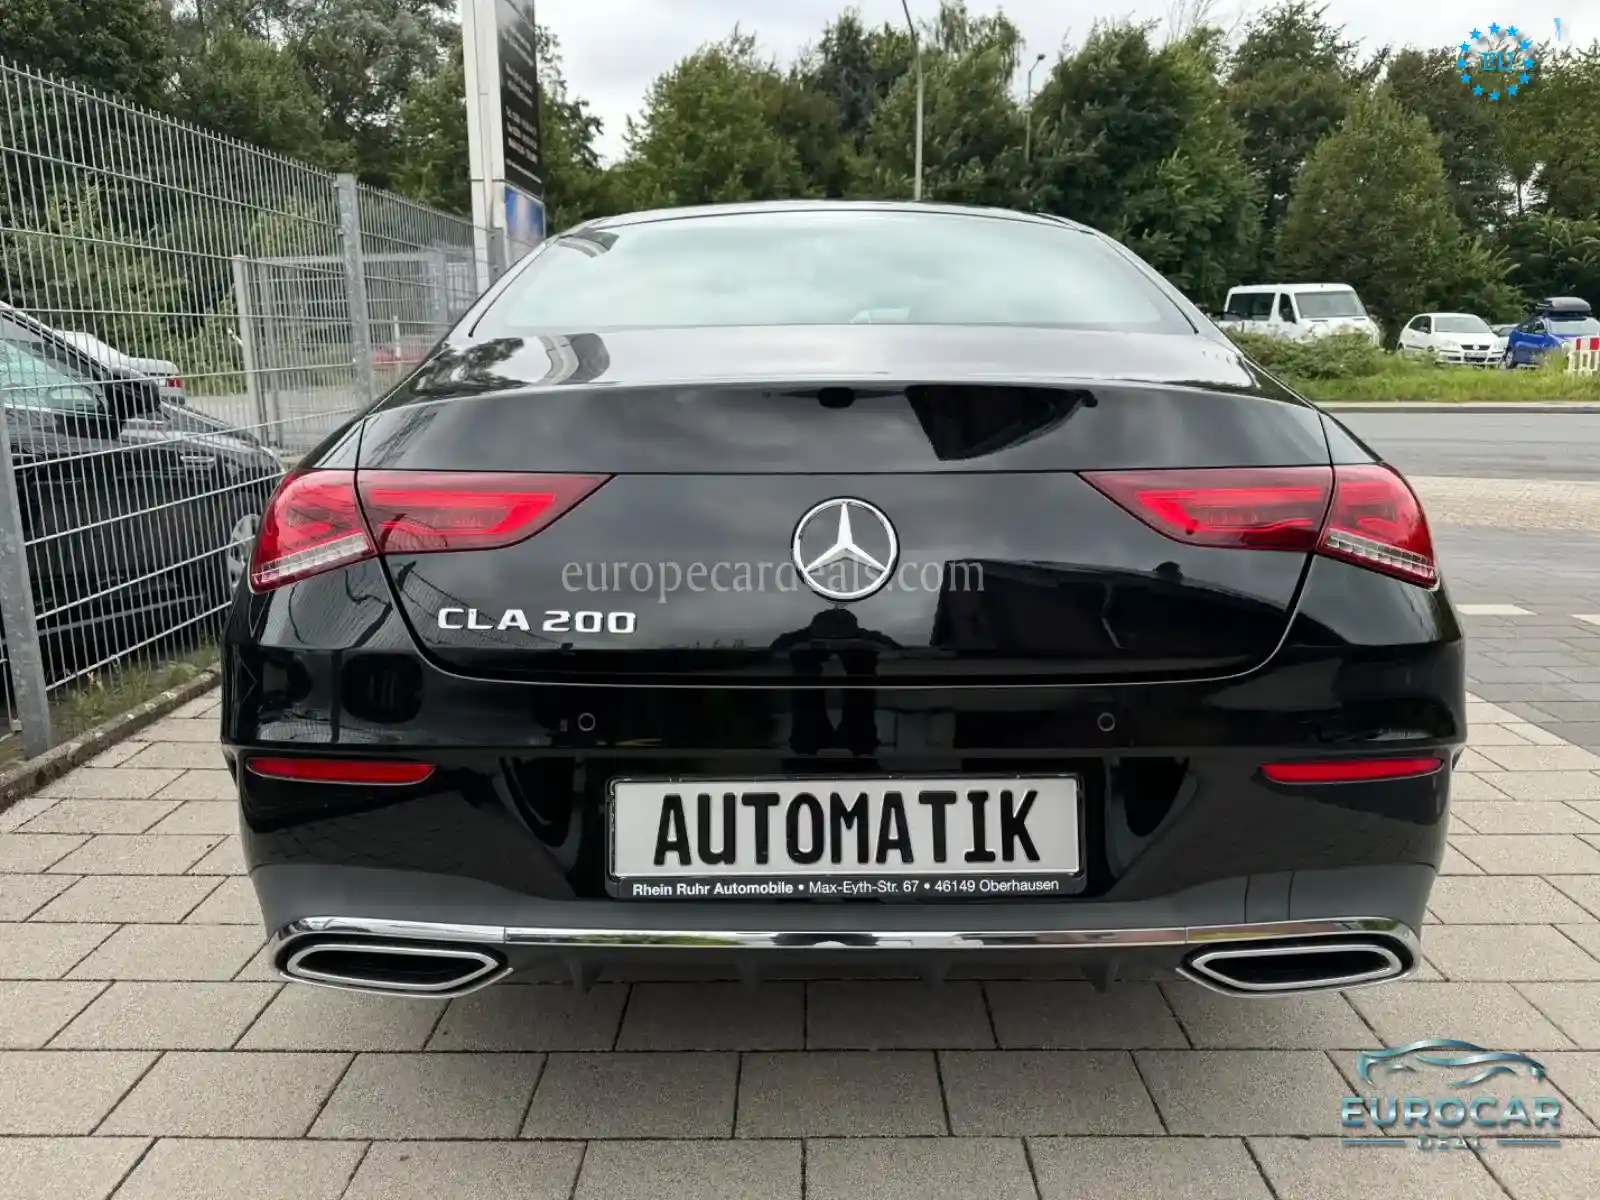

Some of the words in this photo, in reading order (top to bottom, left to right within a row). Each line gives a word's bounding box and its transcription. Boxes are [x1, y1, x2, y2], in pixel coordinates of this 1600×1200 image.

[437, 607, 531, 631] CLA
[542, 610, 637, 634] 200
[653, 790, 1041, 866] AUTOMATIK
[632, 883, 672, 896] Rhein
[676, 883, 709, 896] Ruhr
[713, 881, 794, 895] Automobile
[808, 880, 899, 895] Max-Eyth-Str.
[903, 880, 919, 892] 67
[934, 879, 976, 893] 46149
[979, 878, 1060, 892] Oberhausen
